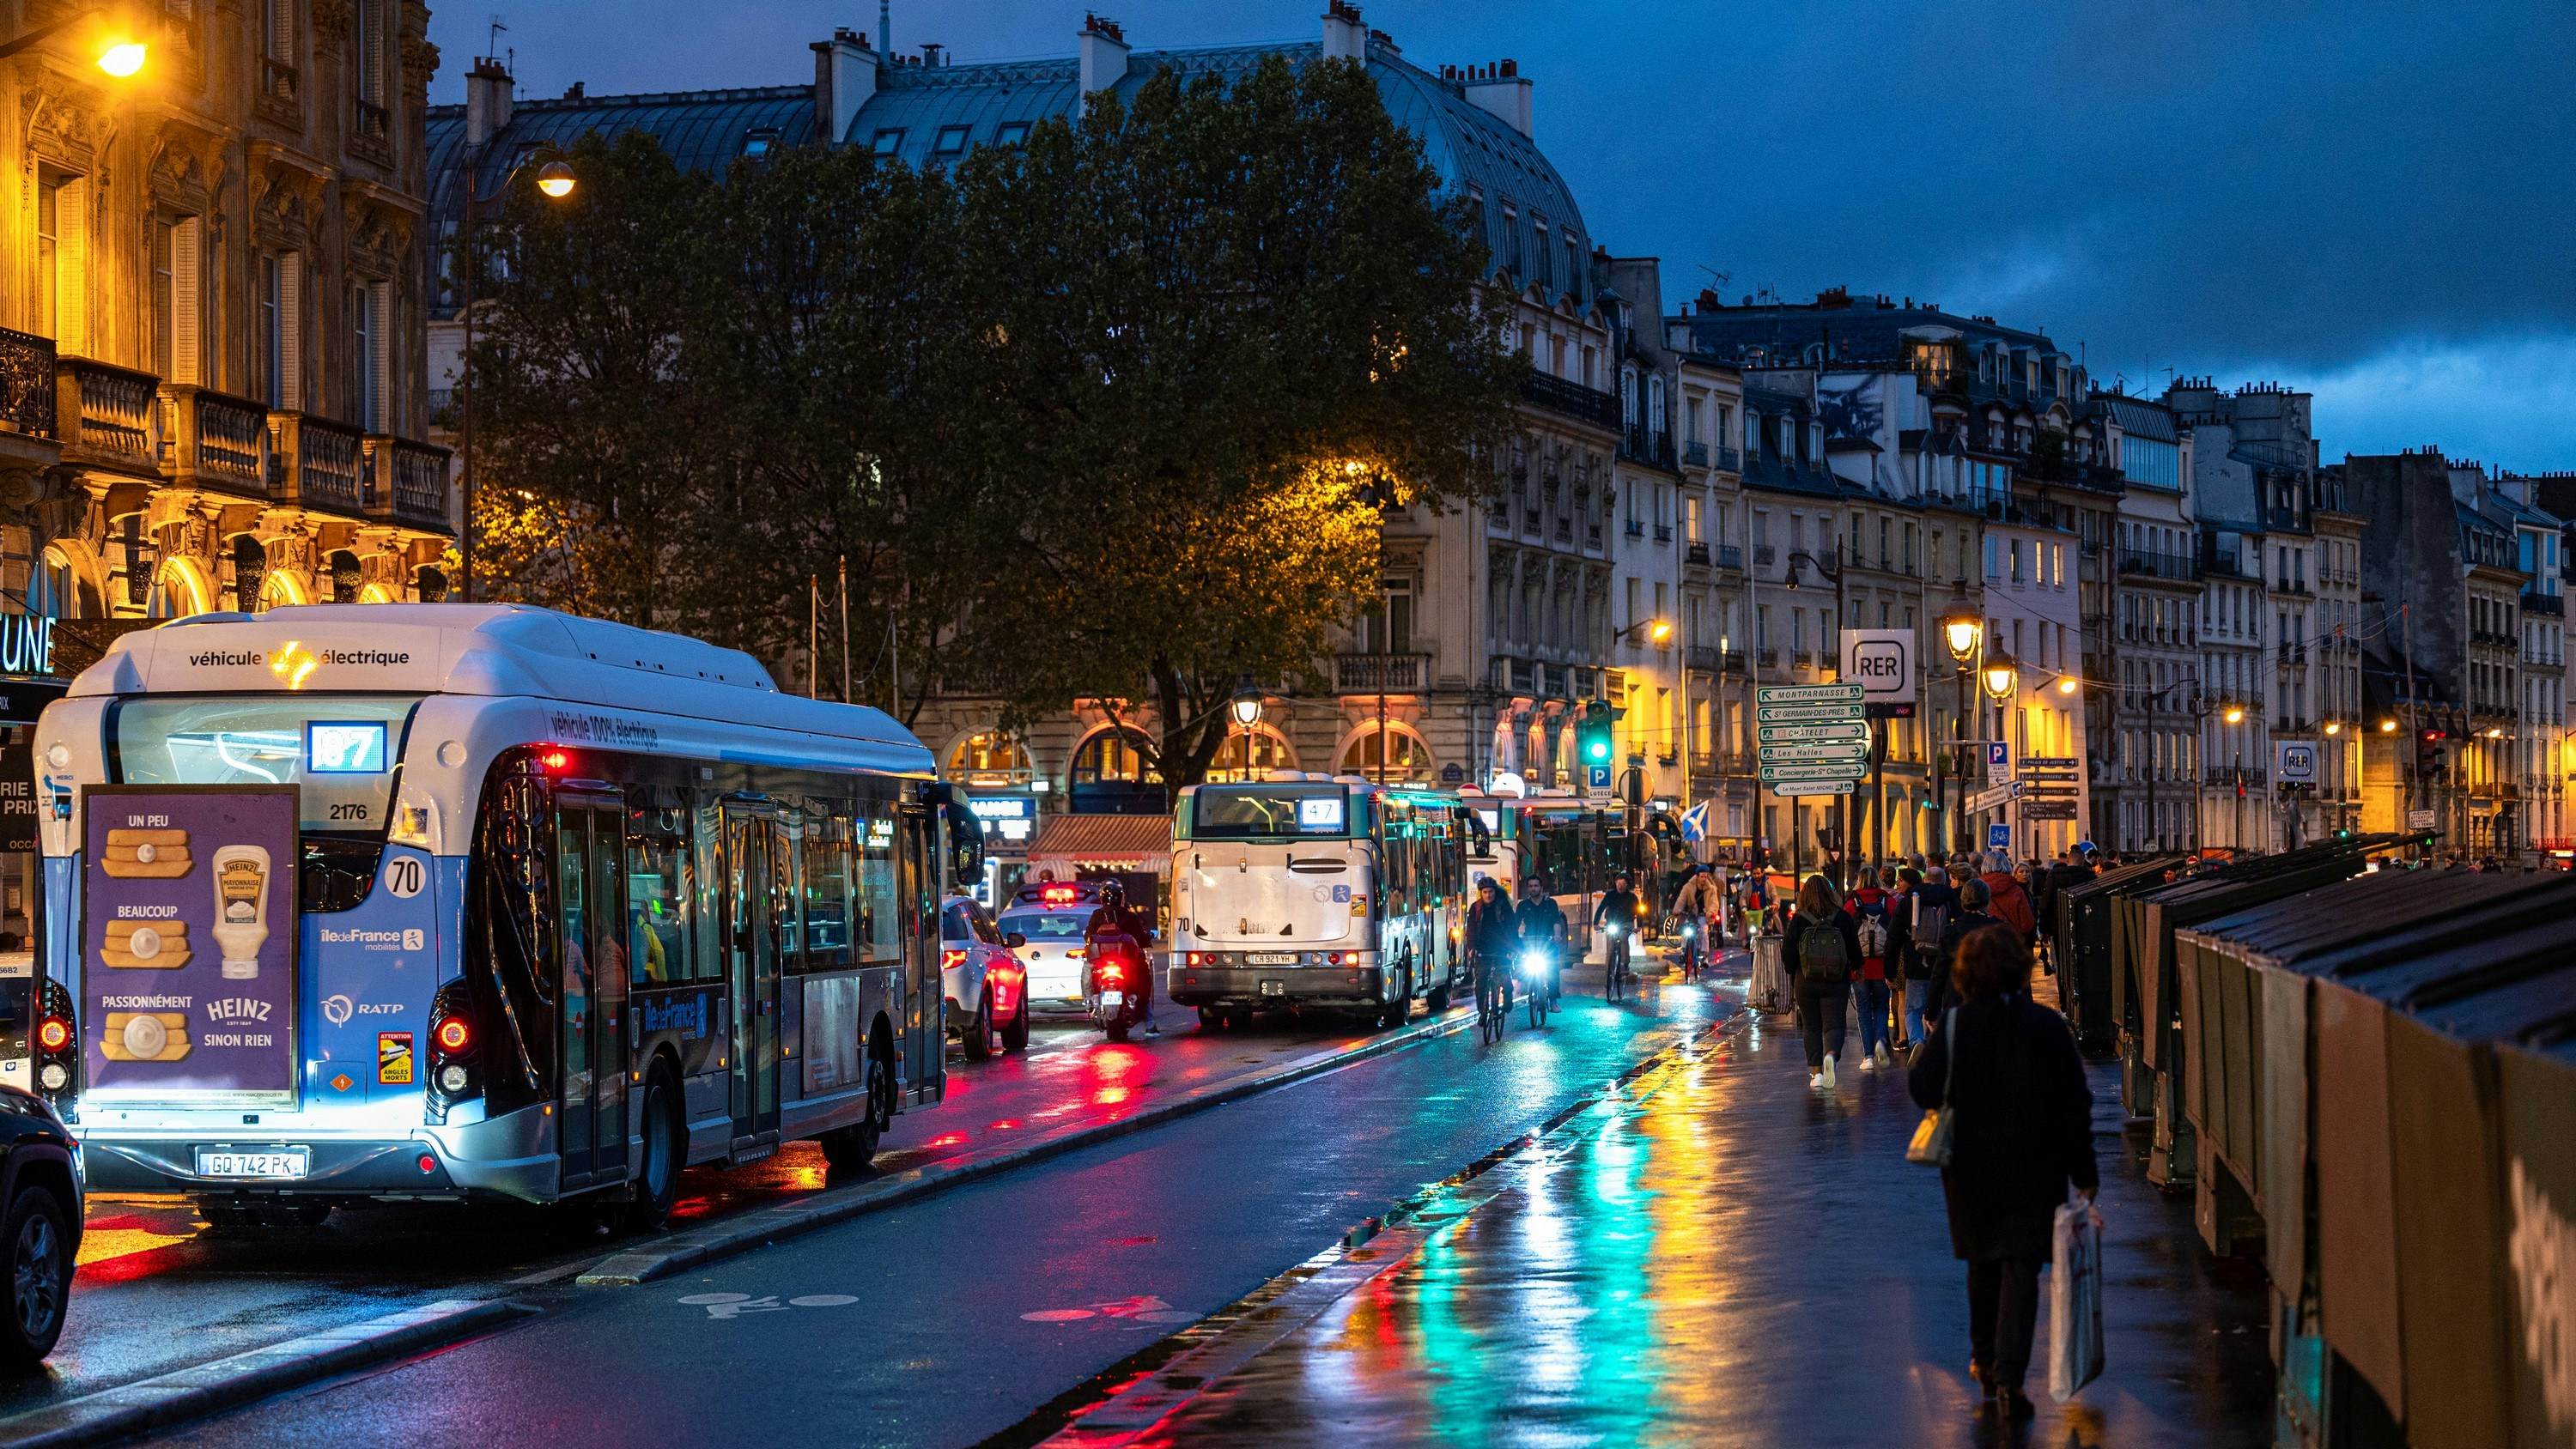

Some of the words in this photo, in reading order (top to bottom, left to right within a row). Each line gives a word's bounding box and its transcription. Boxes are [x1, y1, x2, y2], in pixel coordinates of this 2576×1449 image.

[0, 613, 56, 673] UNE
[190, 651, 262, 666] véhicule
[320, 650, 410, 667] électrique
[1860, 658, 1897, 676] RER
[1777, 689, 1845, 699] MONTPARNASSE
[1783, 706, 1845, 718] GERMAIN-DES-PRÉS
[551, 710, 590, 741] véhicule
[590, 715, 617, 744] 100%
[617, 718, 659, 752] électrique
[1789, 728, 1829, 737] CHÂTELET
[1993, 746, 2002, 761] P
[2288, 755, 2308, 767] RER
[1595, 769, 1606, 784] P
[1826, 767, 1852, 776] Chapelle
[331, 804, 368, 820] 2176
[1309, 804, 1333, 819] 47
[129, 815, 144, 827] UN
[148, 815, 168, 827] PEU
[229, 863, 255, 872] HEINZ
[392, 861, 419, 893] 70
[118, 906, 178, 918] BEAUCOUP
[1177, 918, 1189, 931] 70
[365, 943, 400, 951] mobilités
[102, 994, 192, 1008] PASSIONNÉMENT
[206, 997, 272, 1022] HEINZ
[358, 1004, 404, 1014] RATP
[204, 1034, 241, 1046] SINON
[245, 1034, 272, 1046] RIEN
